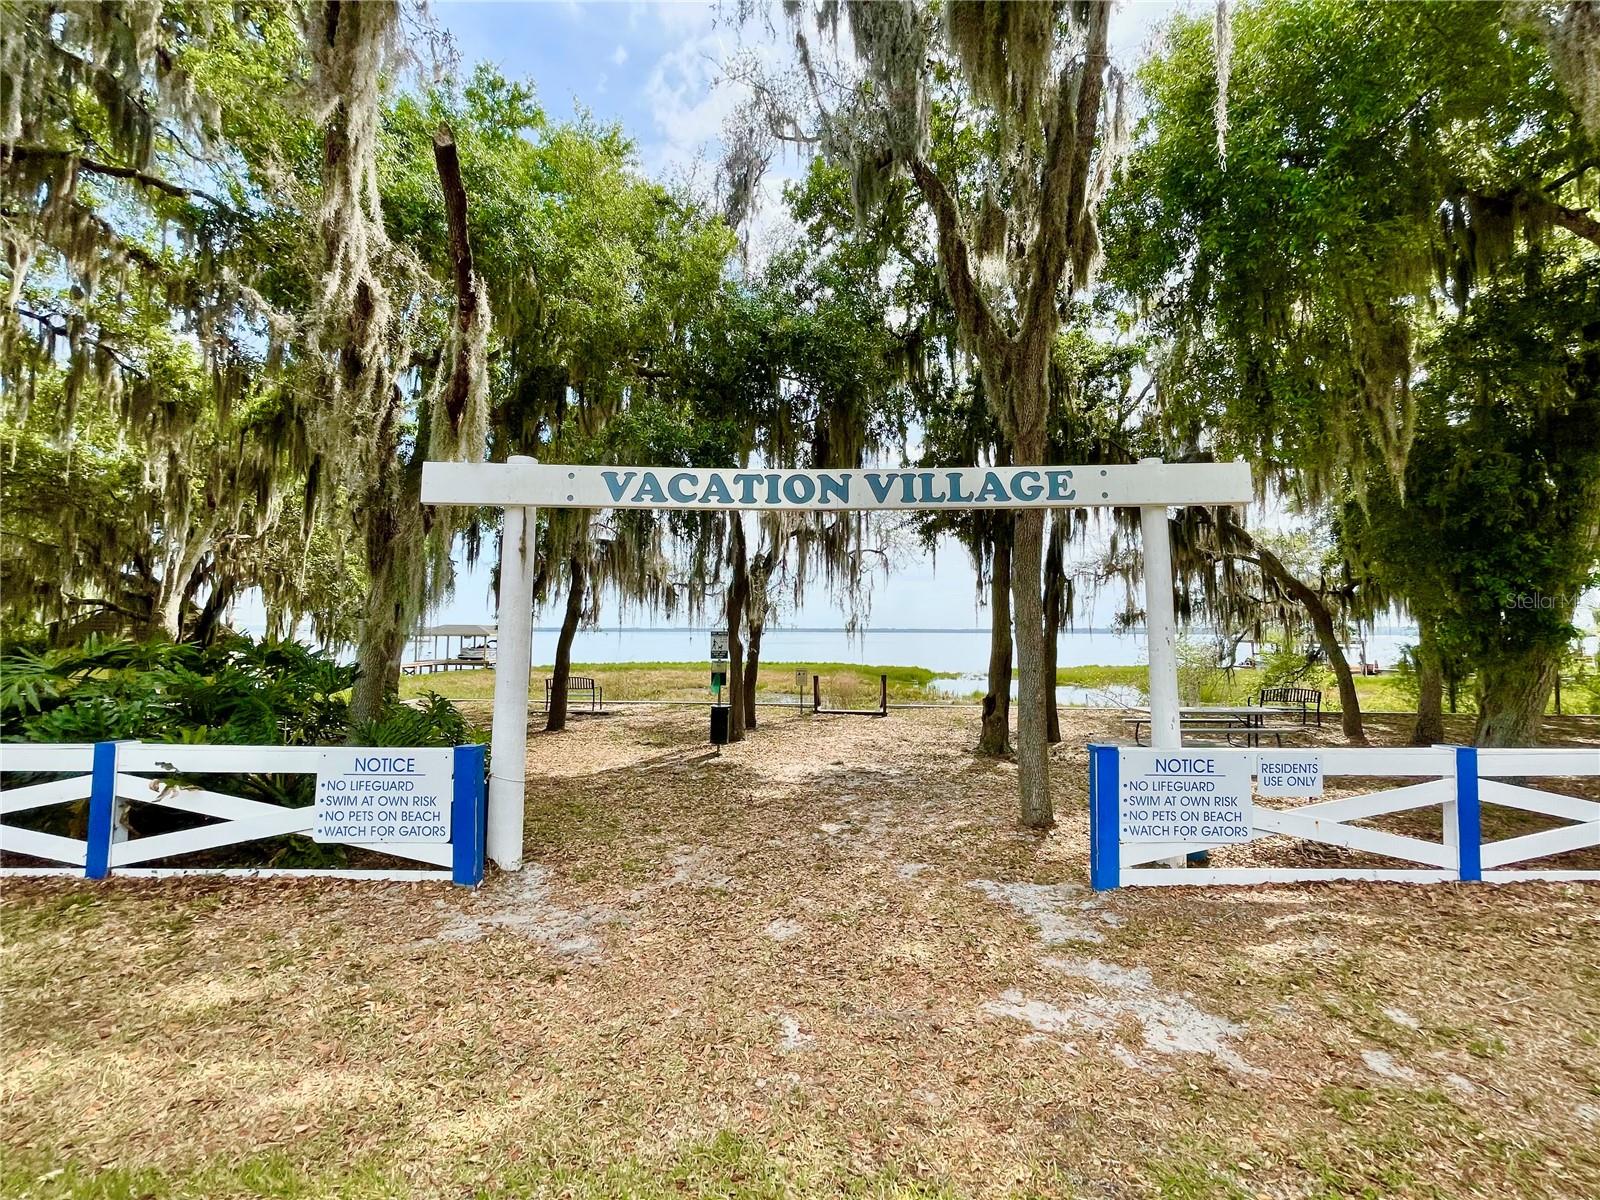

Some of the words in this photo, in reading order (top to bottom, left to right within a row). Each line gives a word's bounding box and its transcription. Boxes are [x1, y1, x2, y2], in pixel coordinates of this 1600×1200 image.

[600, 471, 852, 505] VACATION
[863, 470, 1076, 504] VILLAGE
[355, 758, 415, 772] NOTICE
[1155, 759, 1214, 773] NOTICE
[1262, 763, 1318, 774] RESIDENTS
[327, 780, 346, 791] NO
[351, 781, 414, 791] LIFEGUARD
[1130, 781, 1148, 791] NO
[1153, 781, 1215, 791] LIFEGUARD
[1264, 776, 1283, 786] USE
[1287, 776, 1316, 786] ONLY
[326, 796, 357, 806] SWIM
[361, 796, 374, 806] AT
[378, 796, 408, 806] OWN
[413, 796, 437, 806] RISK
[1129, 796, 1160, 806] SWIM
[1164, 796, 1177, 806] AT
[1180, 796, 1210, 806] OWN
[1214, 796, 1237, 807] RISK
[325, 811, 344, 821] NO
[349, 811, 373, 821] PETS
[378, 811, 397, 821] ON
[402, 811, 440, 821] BEACH
[1130, 811, 1148, 821] NO
[1153, 811, 1176, 821] PETS
[1180, 811, 1199, 821] ON
[1204, 811, 1241, 822] BEACH
[324, 826, 366, 836] WATCH
[371, 826, 395, 836] FOR
[399, 826, 445, 836] GATORS
[1129, 825, 1169, 836] WATCH
[1174, 826, 1197, 836] FOR
[1201, 826, 1248, 837] GATORS
